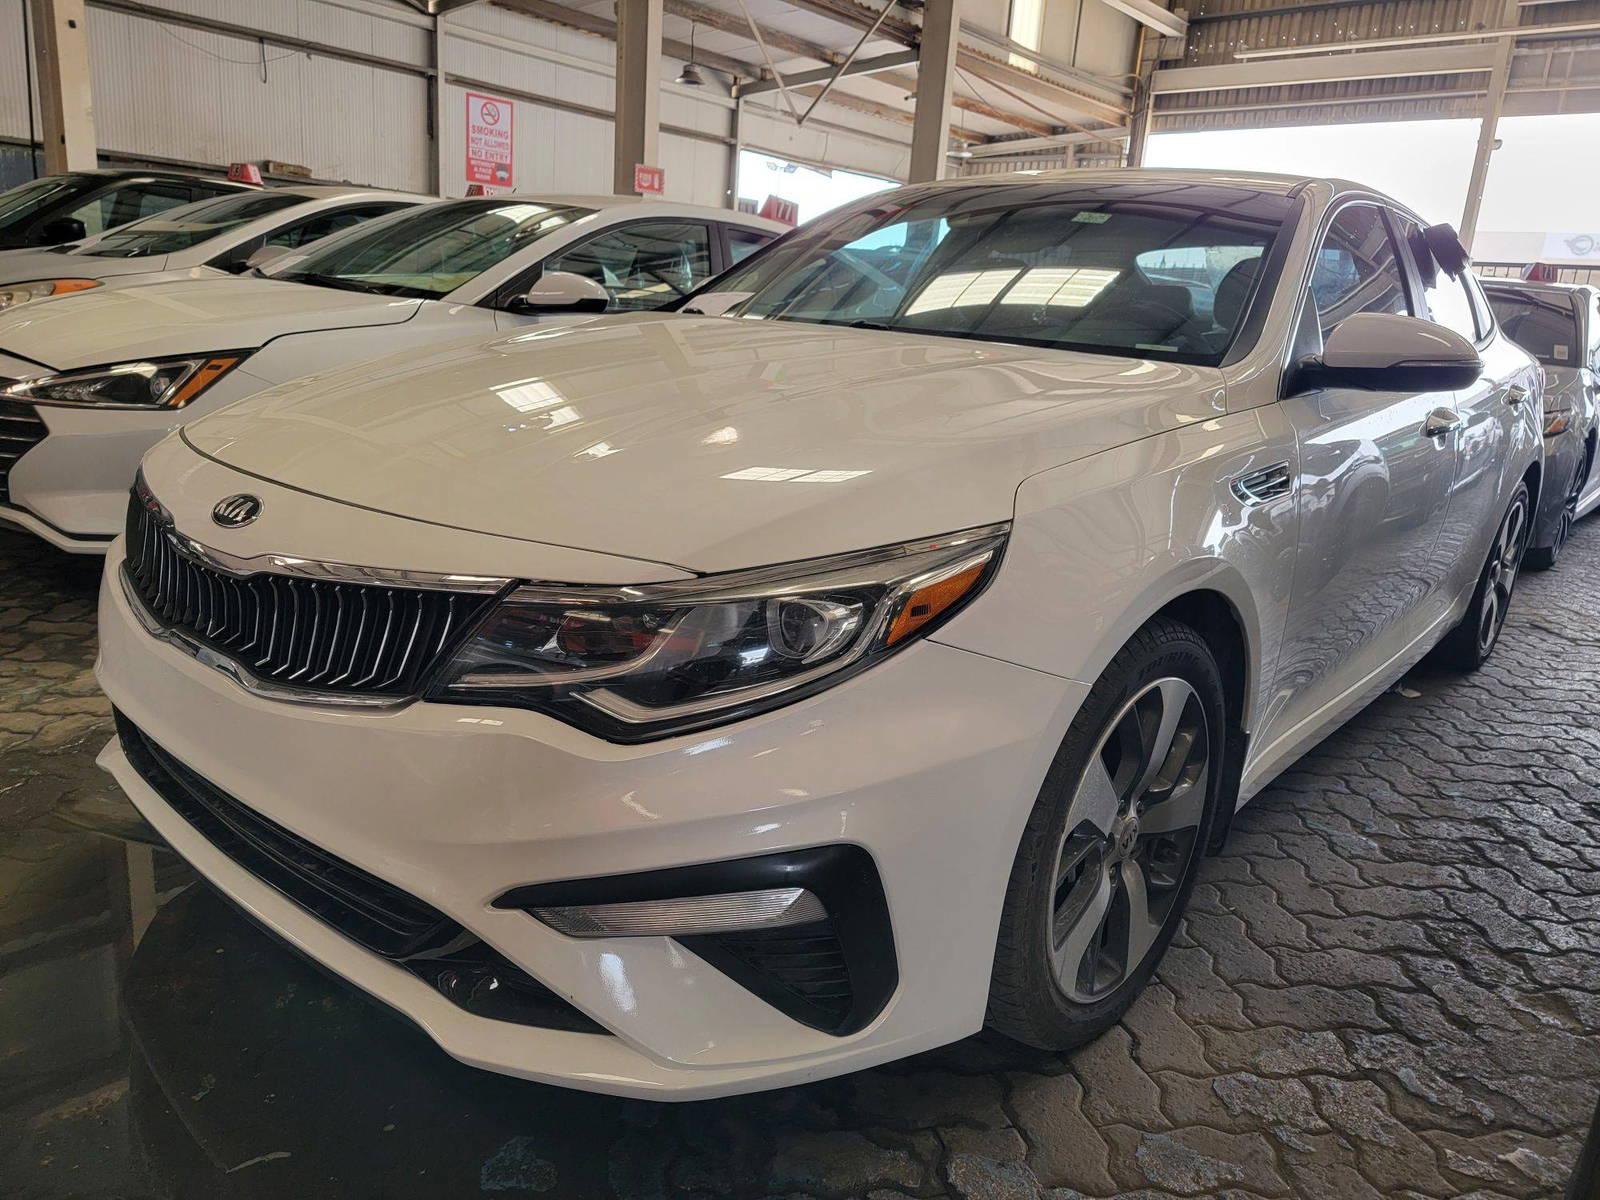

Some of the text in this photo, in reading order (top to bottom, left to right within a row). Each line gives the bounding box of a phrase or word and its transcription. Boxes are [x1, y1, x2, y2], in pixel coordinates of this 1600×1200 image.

[472, 125, 508, 139] SMOKING
[471, 137, 482, 146] NOT
[472, 149, 508, 162] NO ENTRY
[214, 497, 254, 521] KIA
